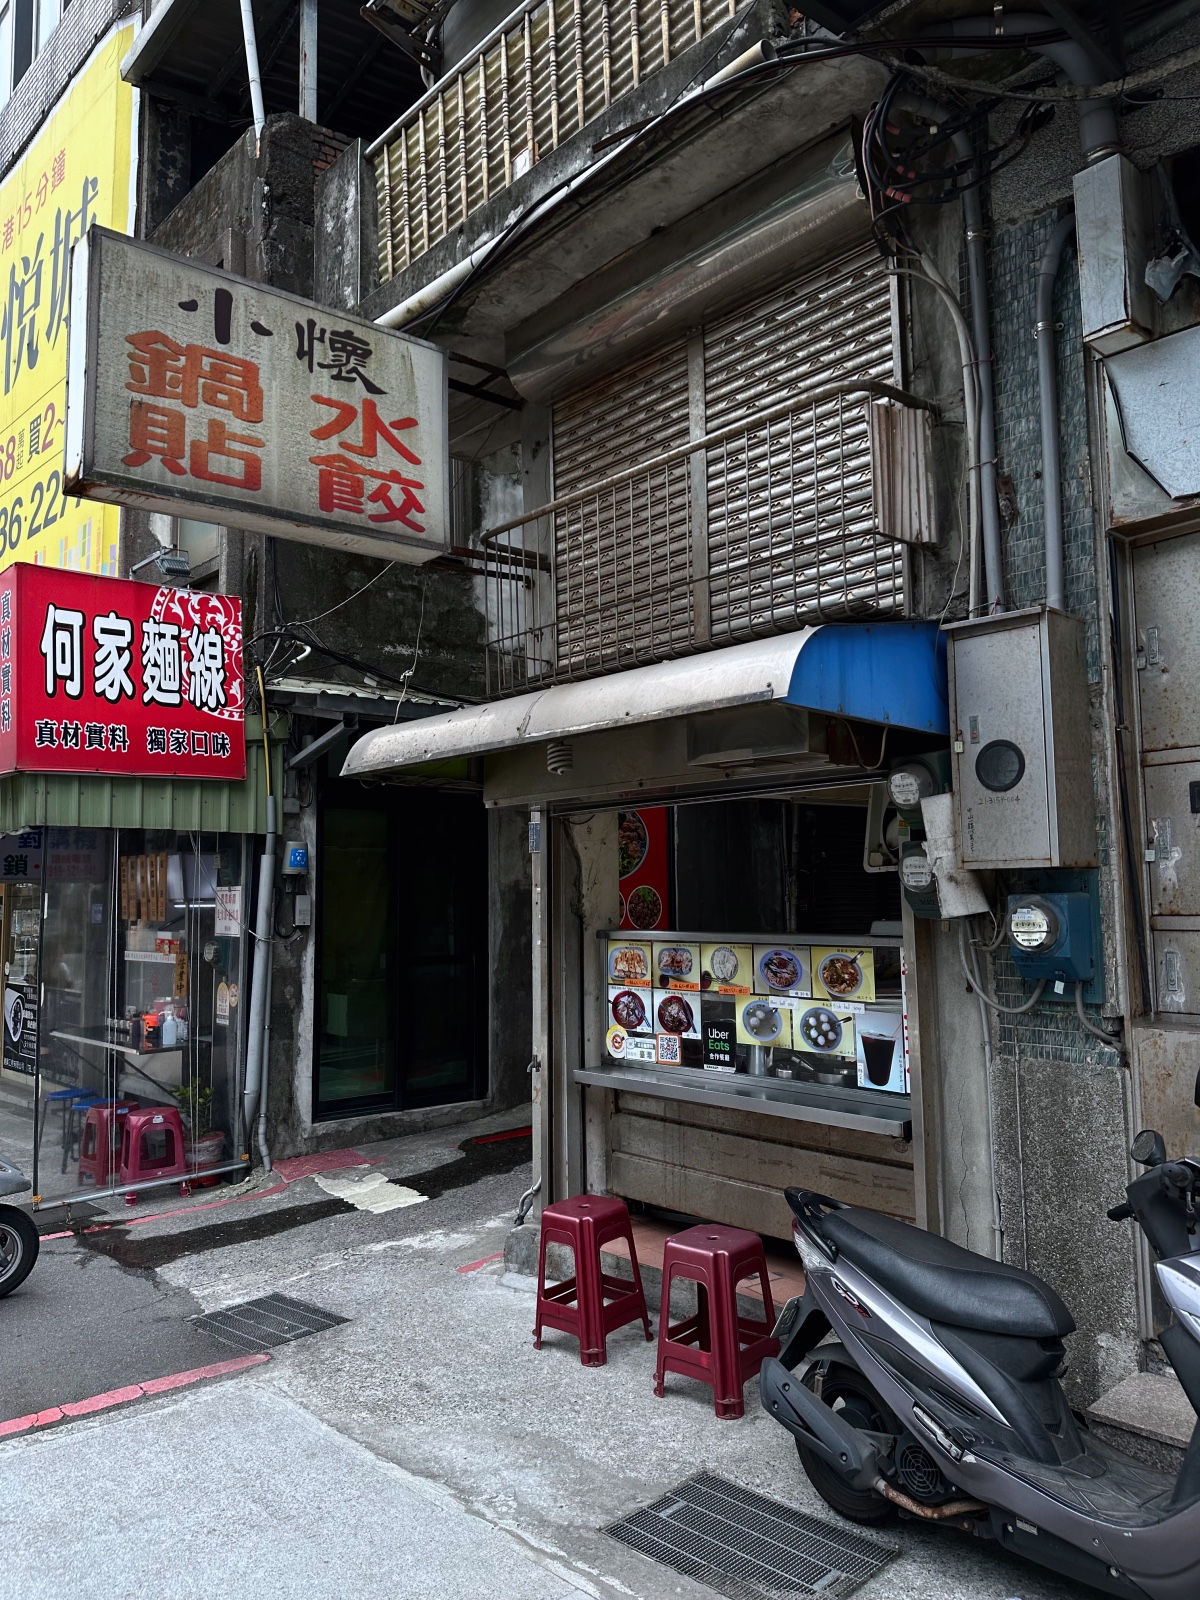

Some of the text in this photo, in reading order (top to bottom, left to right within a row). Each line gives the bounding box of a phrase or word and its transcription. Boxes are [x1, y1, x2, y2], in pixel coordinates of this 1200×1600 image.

[122, 330, 265, 491] 鍋貼
[309, 394, 425, 533] 水餃
[40, 603, 228, 711] 何家麵線
[35, 718, 231, 757] 真材實料 獨家口味
[708, 1028, 729, 1039] Uber
[709, 1039, 730, 1051] Eats
